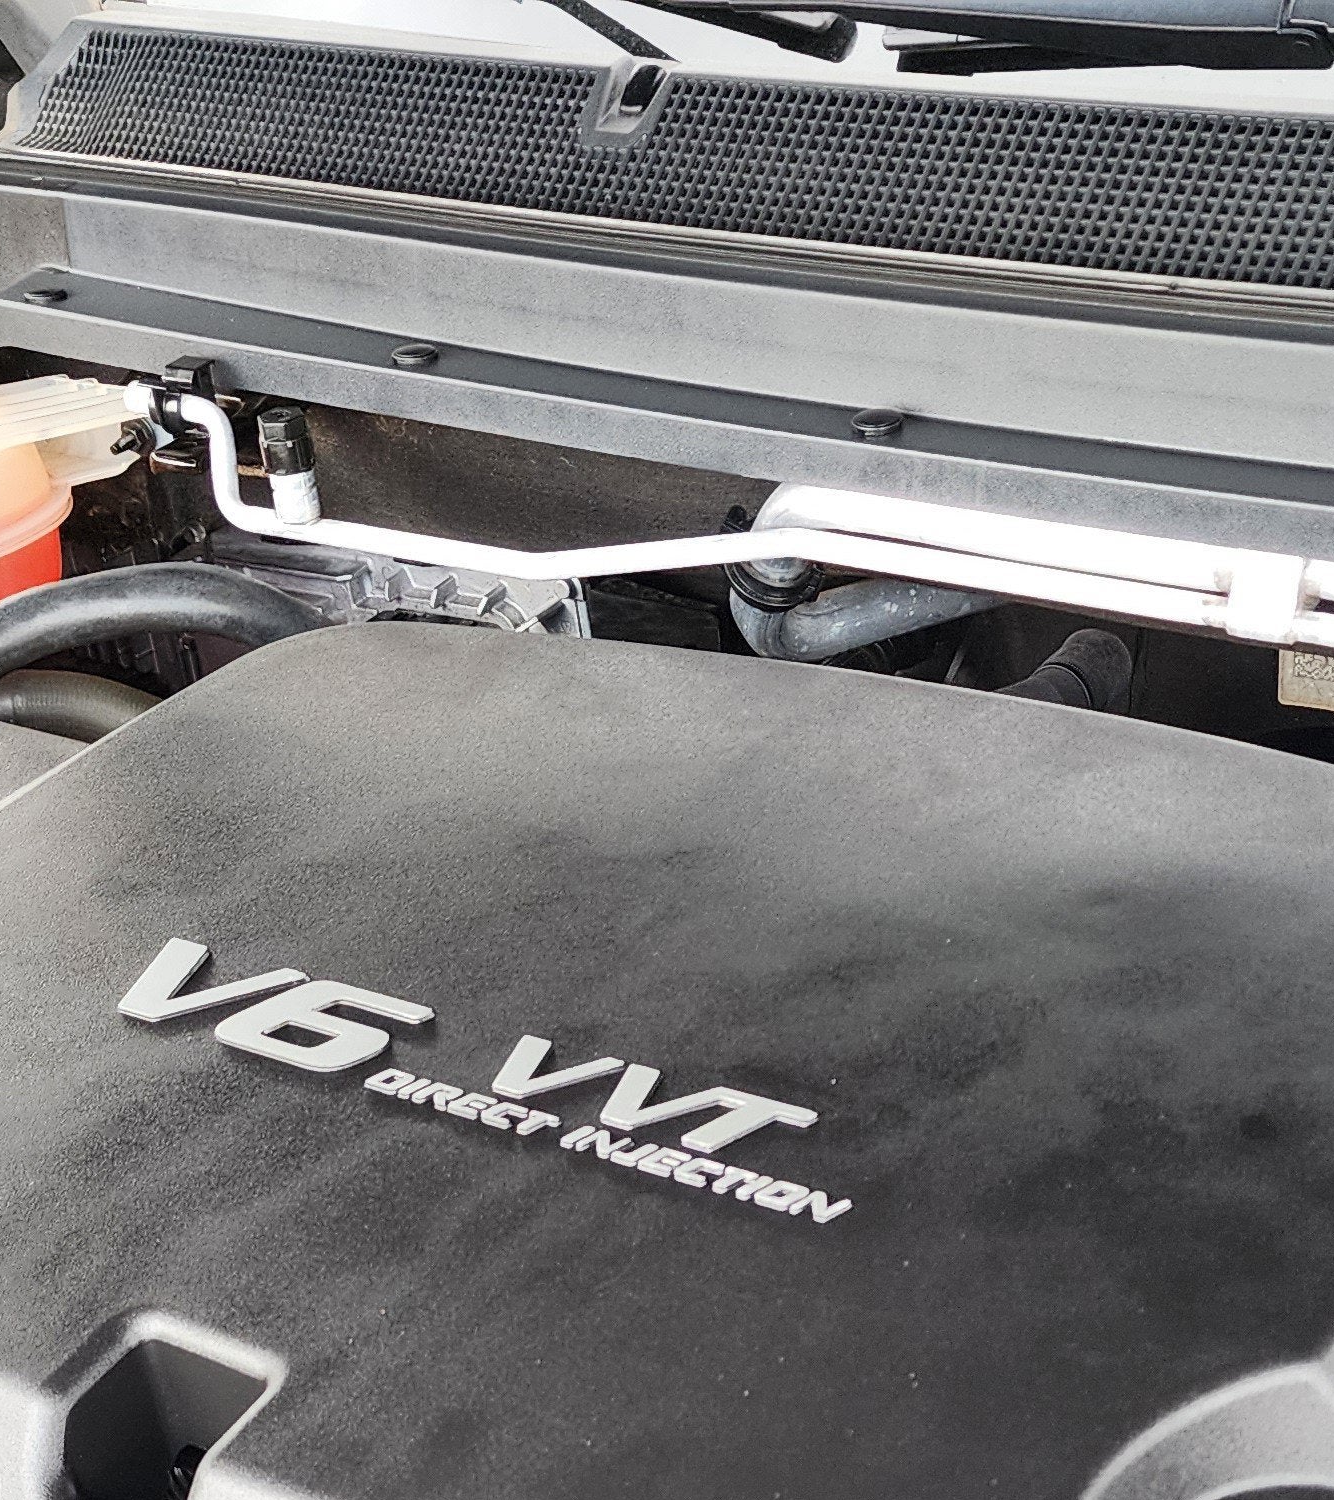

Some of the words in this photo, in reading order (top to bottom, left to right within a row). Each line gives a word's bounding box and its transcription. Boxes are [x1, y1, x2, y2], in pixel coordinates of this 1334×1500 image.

[118, 937, 435, 1072] V6
[492, 1034, 819, 1154] VVT
[364, 1067, 562, 1136] DIRECT
[560, 1123, 853, 1224] INJECTION
